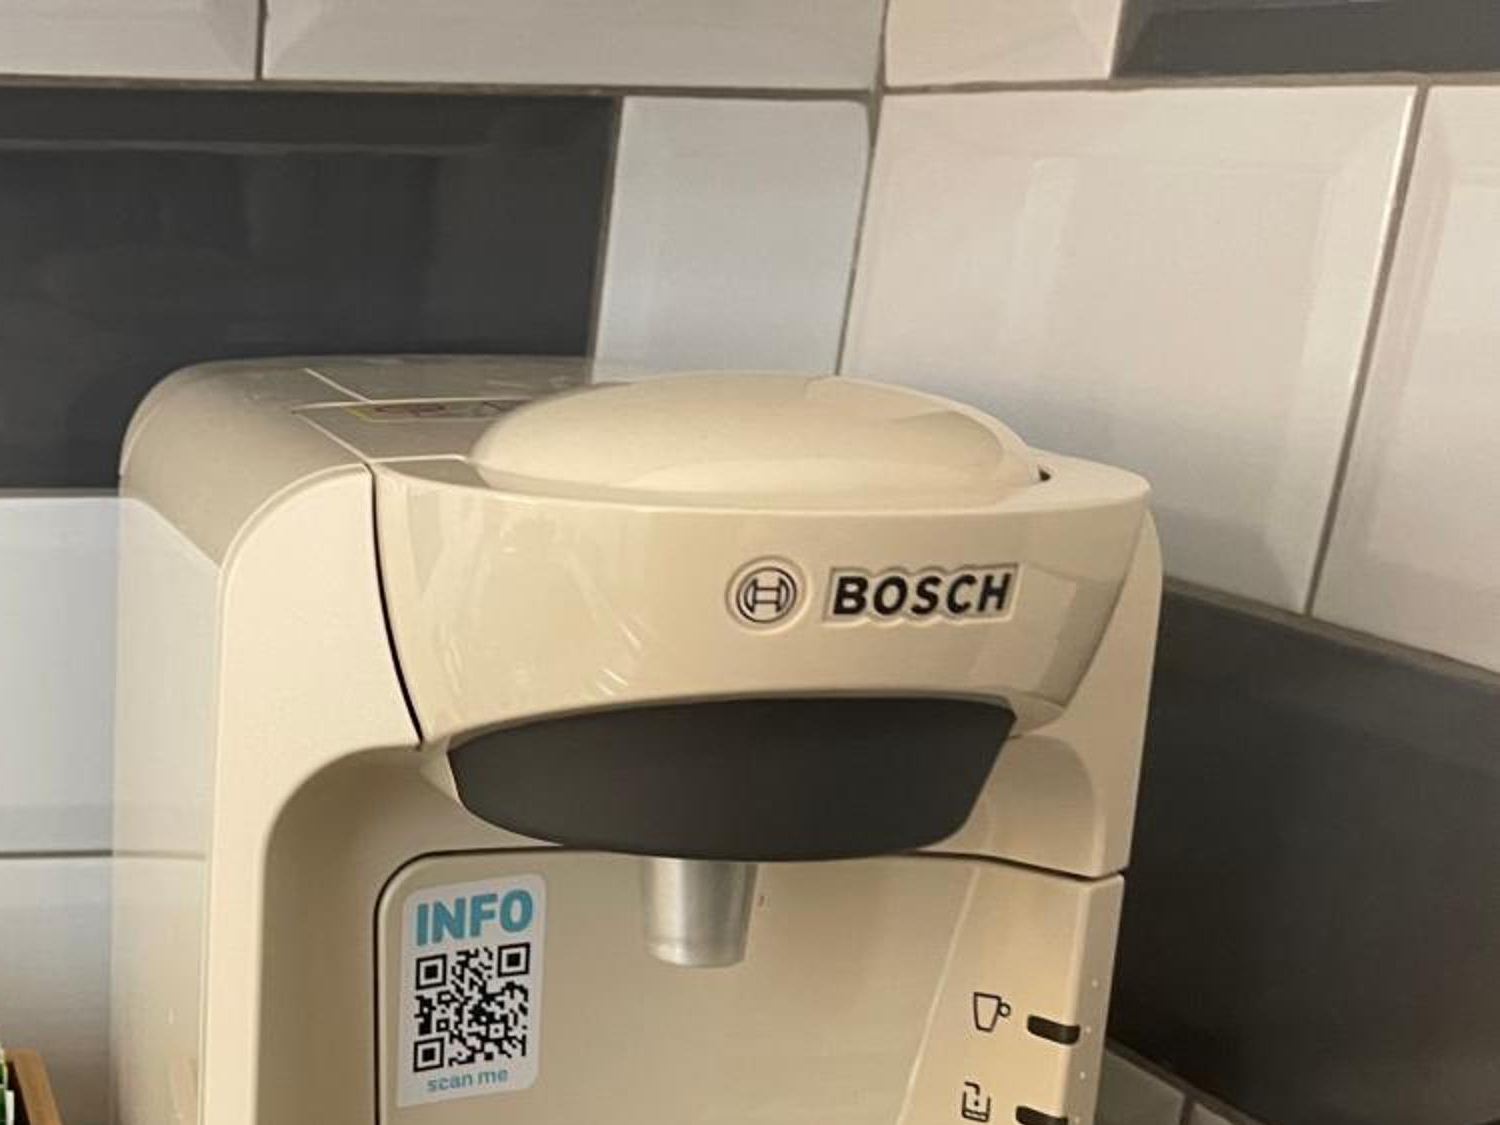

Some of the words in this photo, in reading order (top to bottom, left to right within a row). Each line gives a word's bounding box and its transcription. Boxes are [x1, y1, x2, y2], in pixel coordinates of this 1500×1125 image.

[833, 572, 1012, 615] BOSCH
[417, 889, 534, 947] INFO
[427, 1074, 474, 1092] scan
[478, 1069, 509, 1085] me
